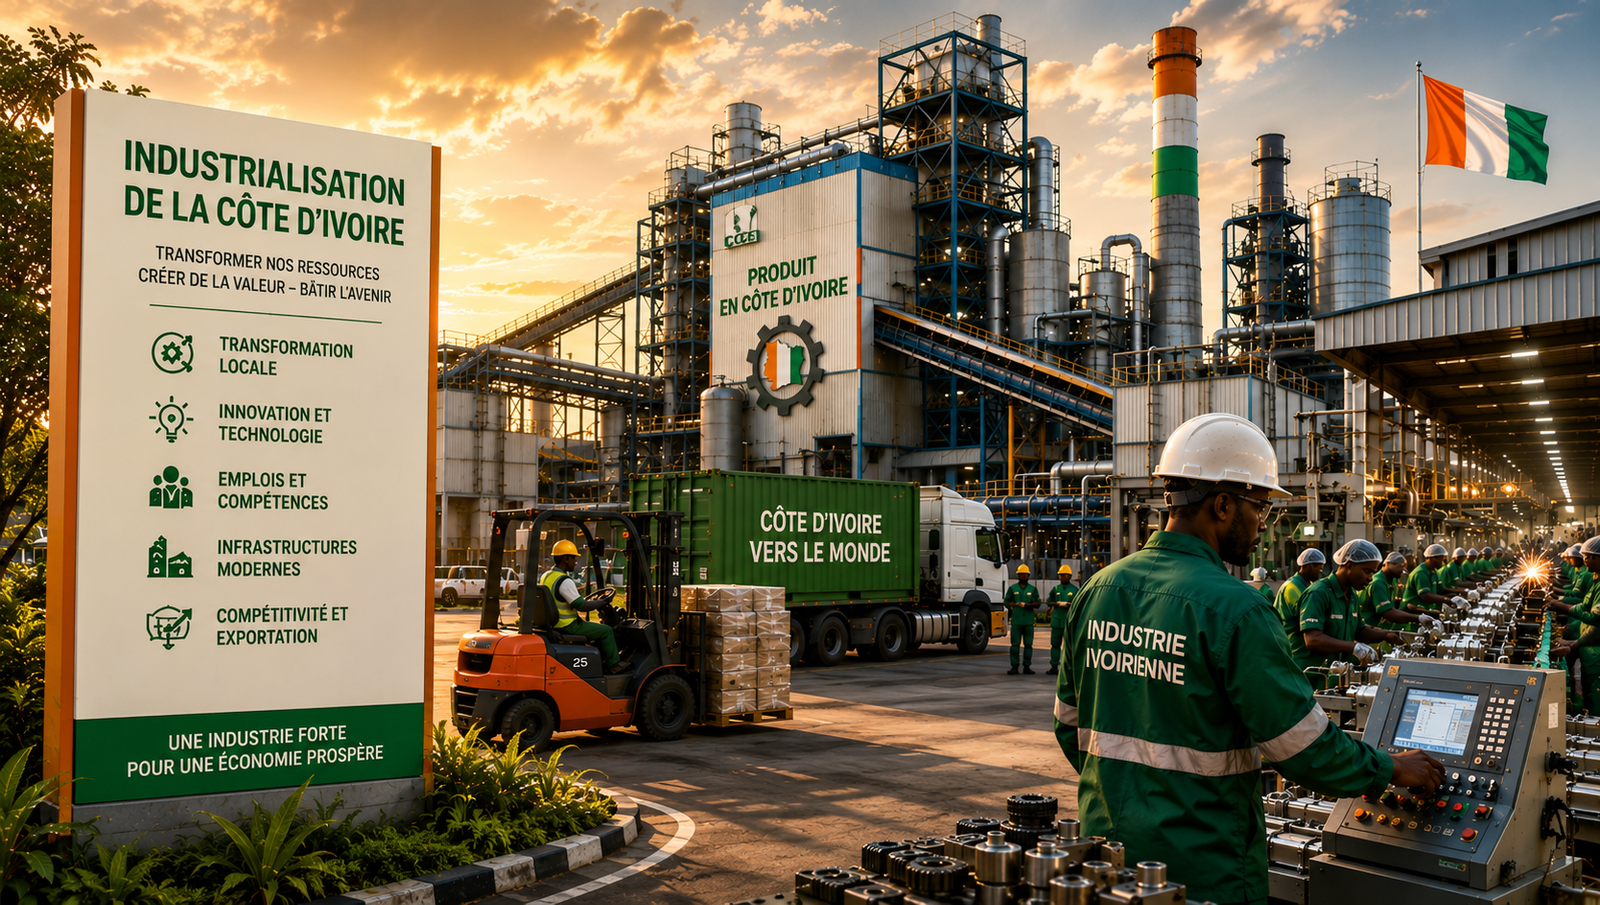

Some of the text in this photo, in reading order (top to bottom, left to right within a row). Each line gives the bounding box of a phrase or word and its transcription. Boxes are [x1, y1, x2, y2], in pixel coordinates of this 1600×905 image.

[124, 139, 405, 206] INDUSTRIALISATION
[124, 185, 404, 246] DE LA CÔTE D'IVOIRE
[156, 246, 380, 280] TRANSFORMER NOS RESSOURCES
[748, 256, 817, 286] PRODUIT
[138, 264, 185, 286] CRÉER
[190, 272, 208, 287] DE
[212, 274, 230, 289] LA
[233, 277, 285, 294] VALEUR
[340, 286, 392, 303] L'AVENIR
[720, 276, 848, 316] EN CÔTE D'IVOIRE
[220, 336, 353, 358] TRANSFORMATION
[219, 358, 277, 376] LOCALE
[219, 404, 332, 422] INNOVATION ET
[219, 426, 323, 444] TECHNOLOGIE
[218, 471, 307, 488] EMPLOIS ET
[218, 491, 328, 510] COMPÉTENCES
[760, 505, 882, 534] CÔTE D'IVOIRE
[218, 540, 357, 555] INFRASTRUCTURES
[749, 541, 890, 563] VERS LE MONDE
[218, 562, 300, 577] MODERNES
[217, 603, 348, 623] COMPÉTITIVITÉ ET
[217, 629, 318, 646] EXPORTATION
[1088, 619, 1186, 657] INDUSTRIE
[573, 657, 588, 668] 25
[1086, 647, 1185, 685] IVOIRIENNE
[168, 725, 347, 751] UNE INDUSTRIE FORTE
[127, 743, 384, 778] POUR UNE ÉCONOMIE PROSPÈRE
